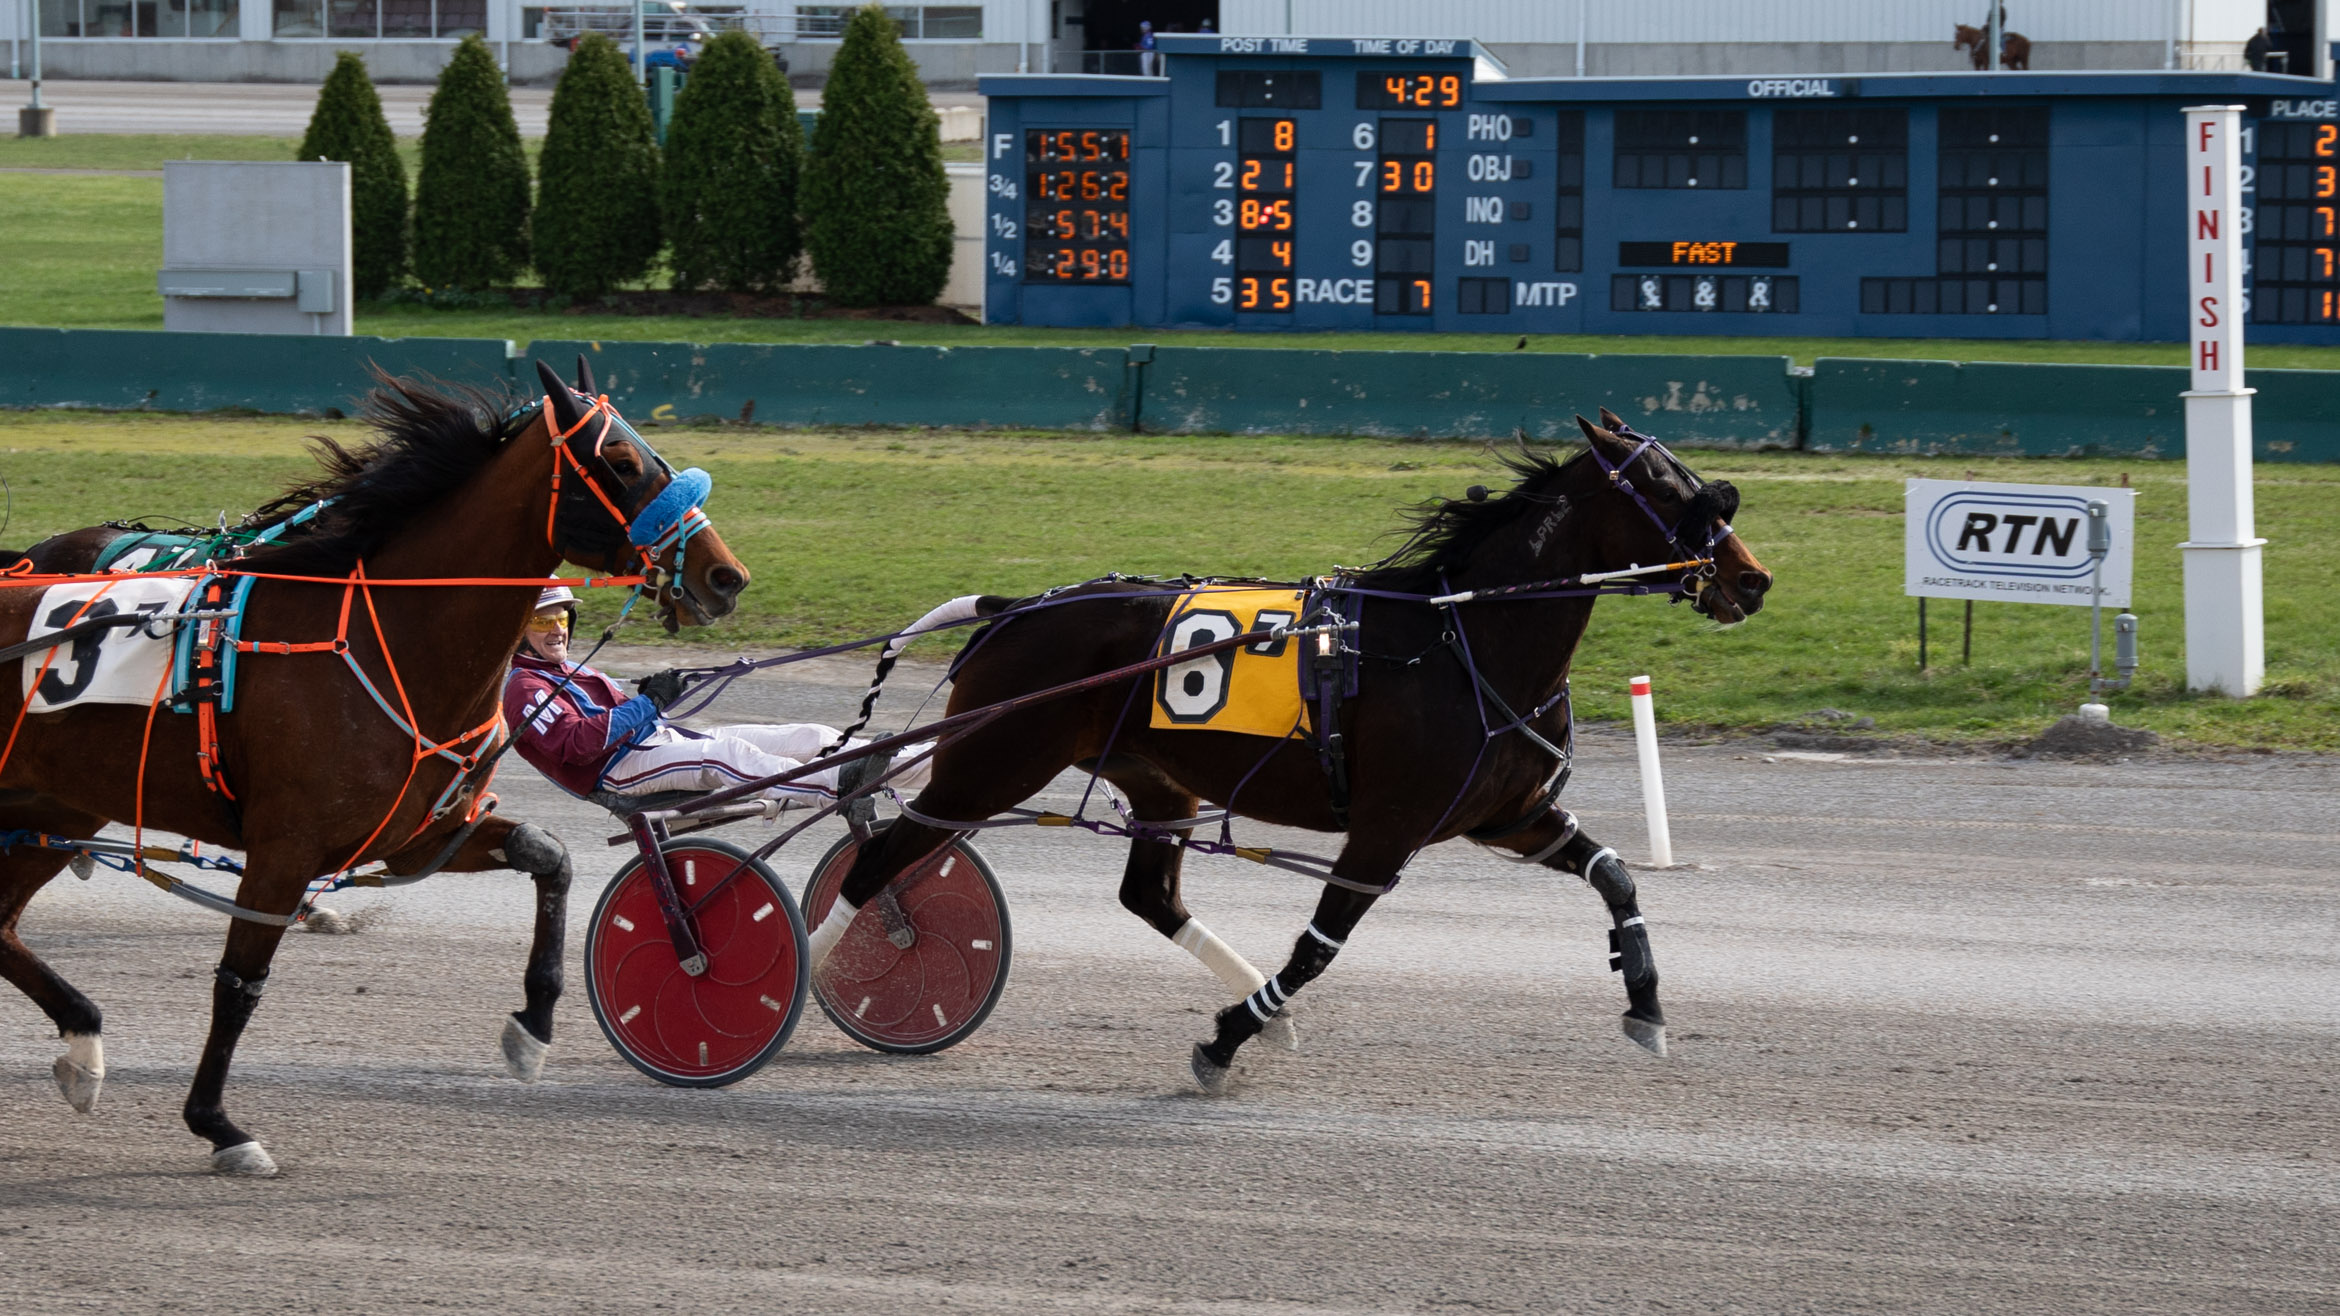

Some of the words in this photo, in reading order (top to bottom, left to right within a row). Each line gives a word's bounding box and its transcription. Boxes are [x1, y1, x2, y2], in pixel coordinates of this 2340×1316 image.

[1220, 38, 1264, 53] POST
[1270, 39, 1308, 53] TIME
[1353, 40, 1391, 54] TIME
[1400, 40, 1418, 54] OF
[1424, 40, 1456, 55] DAY
[1386, 75, 1460, 106] 4:29
[1748, 80, 1834, 97] OFFICIAL
[2271, 100, 2337, 118] PLACE
[1216, 120, 1231, 145] 1
[1274, 120, 1294, 151] 8
[1353, 123, 1374, 150] 6
[1426, 124, 1434, 151] 1
[1468, 114, 1512, 142] PHO
[2240, 127, 2254, 153] 1
[2315, 124, 2337, 156] 2
[993, 134, 1013, 158] F
[1213, 162, 1233, 188] 2
[1354, 161, 1374, 187] 7
[1468, 154, 1512, 182] OBJ
[2240, 165, 2255, 192] 2
[989, 175, 1018, 199] 3/4
[2316, 166, 2336, 198] 3
[1213, 199, 1233, 225] 3
[1352, 201, 1373, 228] 8
[1466, 197, 1503, 224] INQ
[2240, 206, 2253, 234] 3
[990, 213, 1018, 239] 1/2
[1211, 240, 1233, 265] 4
[1272, 241, 1292, 268] 4
[1351, 240, 1373, 266] 9
[1465, 240, 1494, 266] DH
[1672, 242, 1737, 264] FAST
[2197, 121, 2219, 371] FINISH
[990, 251, 1017, 276] 1/4
[1211, 278, 1232, 303] 5
[1297, 278, 1374, 303] RACE
[1413, 280, 1431, 308] 7
[1516, 282, 1577, 306] MTP
[1956, 512, 2080, 557] RTN
[1922, 576, 1987, 590] RACETRACK
[1989, 580, 2050, 593] TELEVISION
[2053, 584, 2109, 596] NETWOK
[1248, 610, 1295, 655] 7
[35, 598, 119, 705] 3
[521, 688, 564, 736] M
